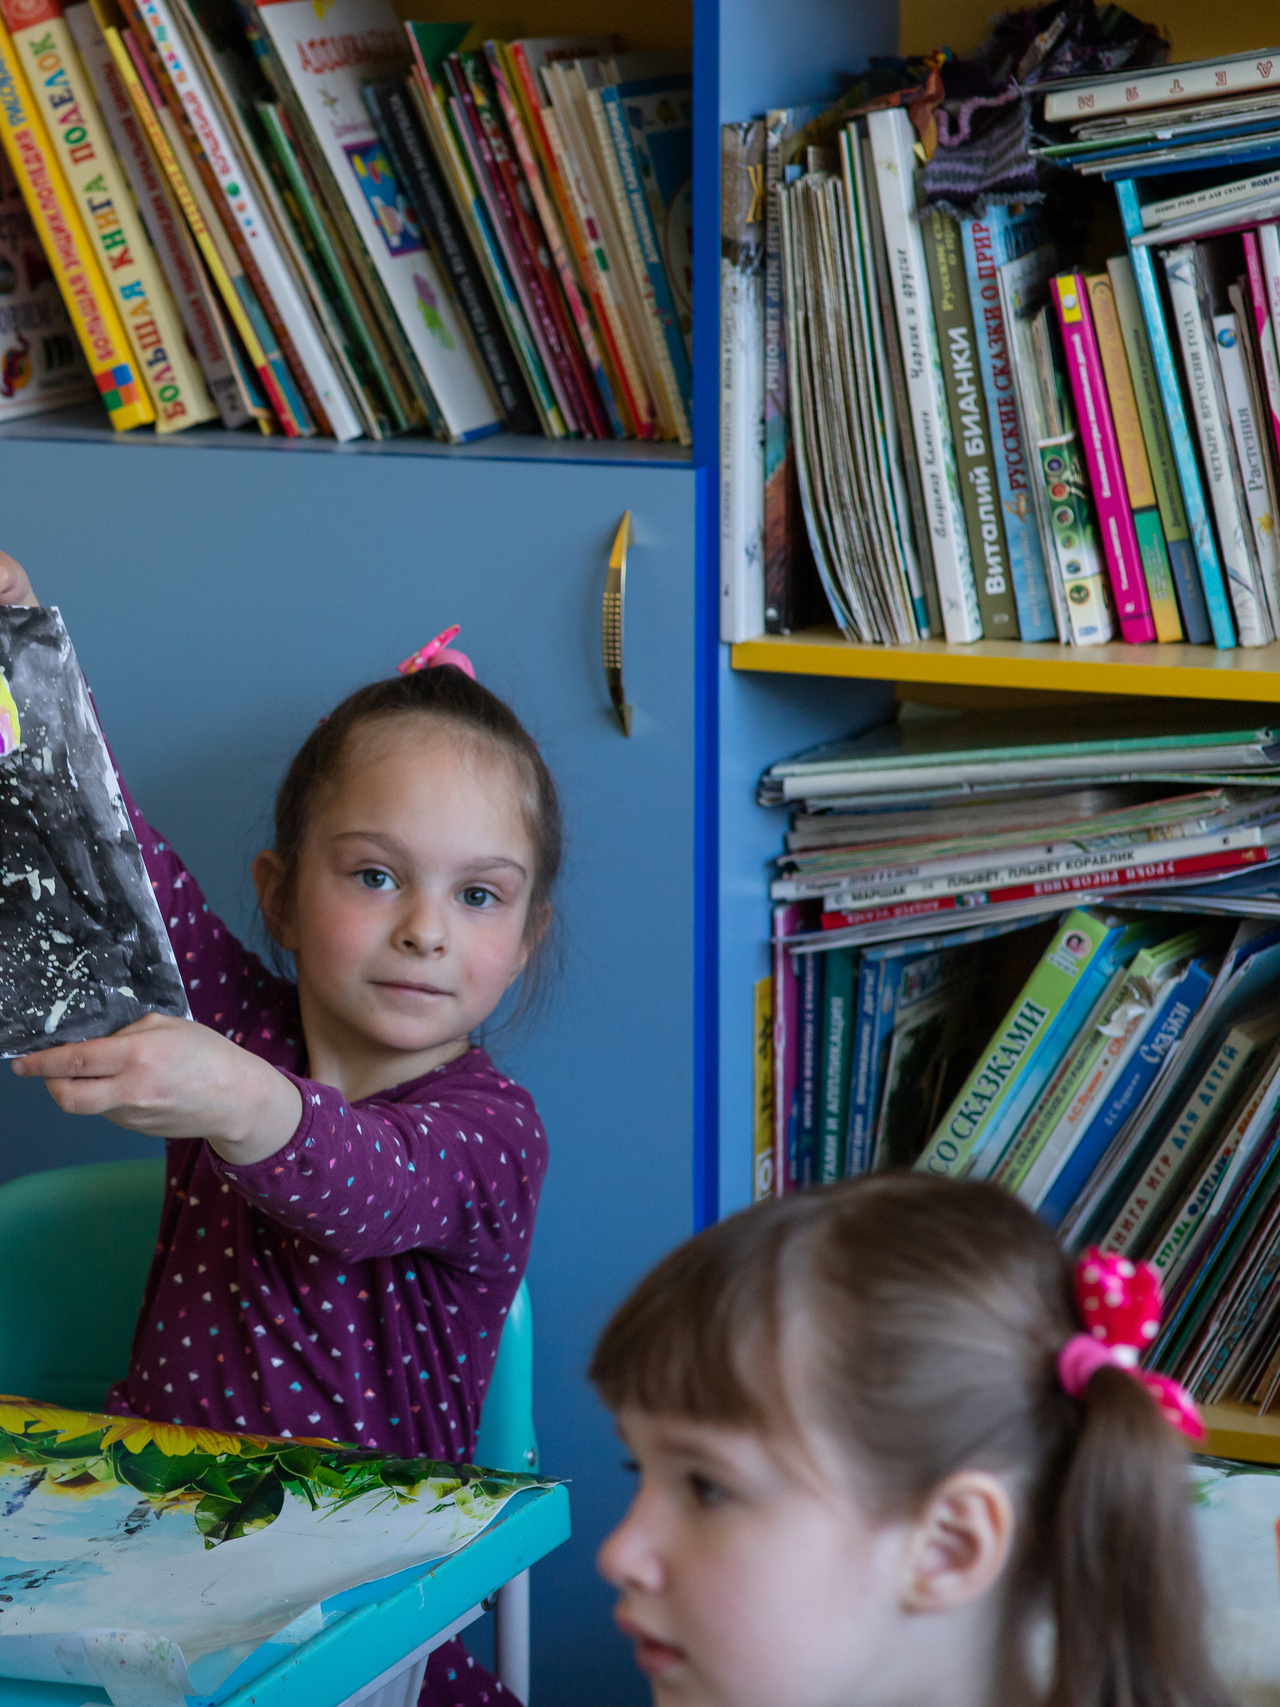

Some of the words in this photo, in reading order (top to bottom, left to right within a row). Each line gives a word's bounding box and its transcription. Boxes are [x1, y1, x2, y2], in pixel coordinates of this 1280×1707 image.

[28, 32, 96, 166] ПОДЕЛОК
[14, 128, 80, 272] ЭНЦИКЛОПЕДИЯ
[83, 173, 135, 271] КНИГА
[1251, 171, 1280, 189] ПОДЕЛ
[972, 220, 997, 281] ПРИР
[980, 284, 999, 301] О
[68, 272, 115, 362] БОЛЬШАЯ
[119, 280, 187, 421] БОЛЬШАЯ
[984, 305, 1014, 392] СКАЗКИ
[1182, 311, 1198, 348] ГОДА
[948, 326, 986, 457] БИАНКИ
[1191, 351, 1212, 420] ВРЕМЕНИ
[997, 394, 1028, 491] РУССКИЕ
[1205, 424, 1224, 482] ЧЕТЫРЕ
[1238, 407, 1264, 492] Растения
[969, 465, 1006, 595] Виталий
[1064, 850, 1136, 871] КОРАБЛИК
[827, 996, 844, 1114] АППЛИКАЦИЯ
[1140, 1001, 1190, 1065] Сказки
[927, 1138, 960, 1176] СО
[949, 1000, 1048, 1142] СКАЗКАМИ
[1145, 1154, 1171, 1192] ИГР
[1171, 1111, 1199, 1150] ДЛЯ
[1198, 1045, 1238, 1107] ДЕТЕЙ
[1155, 1220, 1190, 1268] СТРАНА
